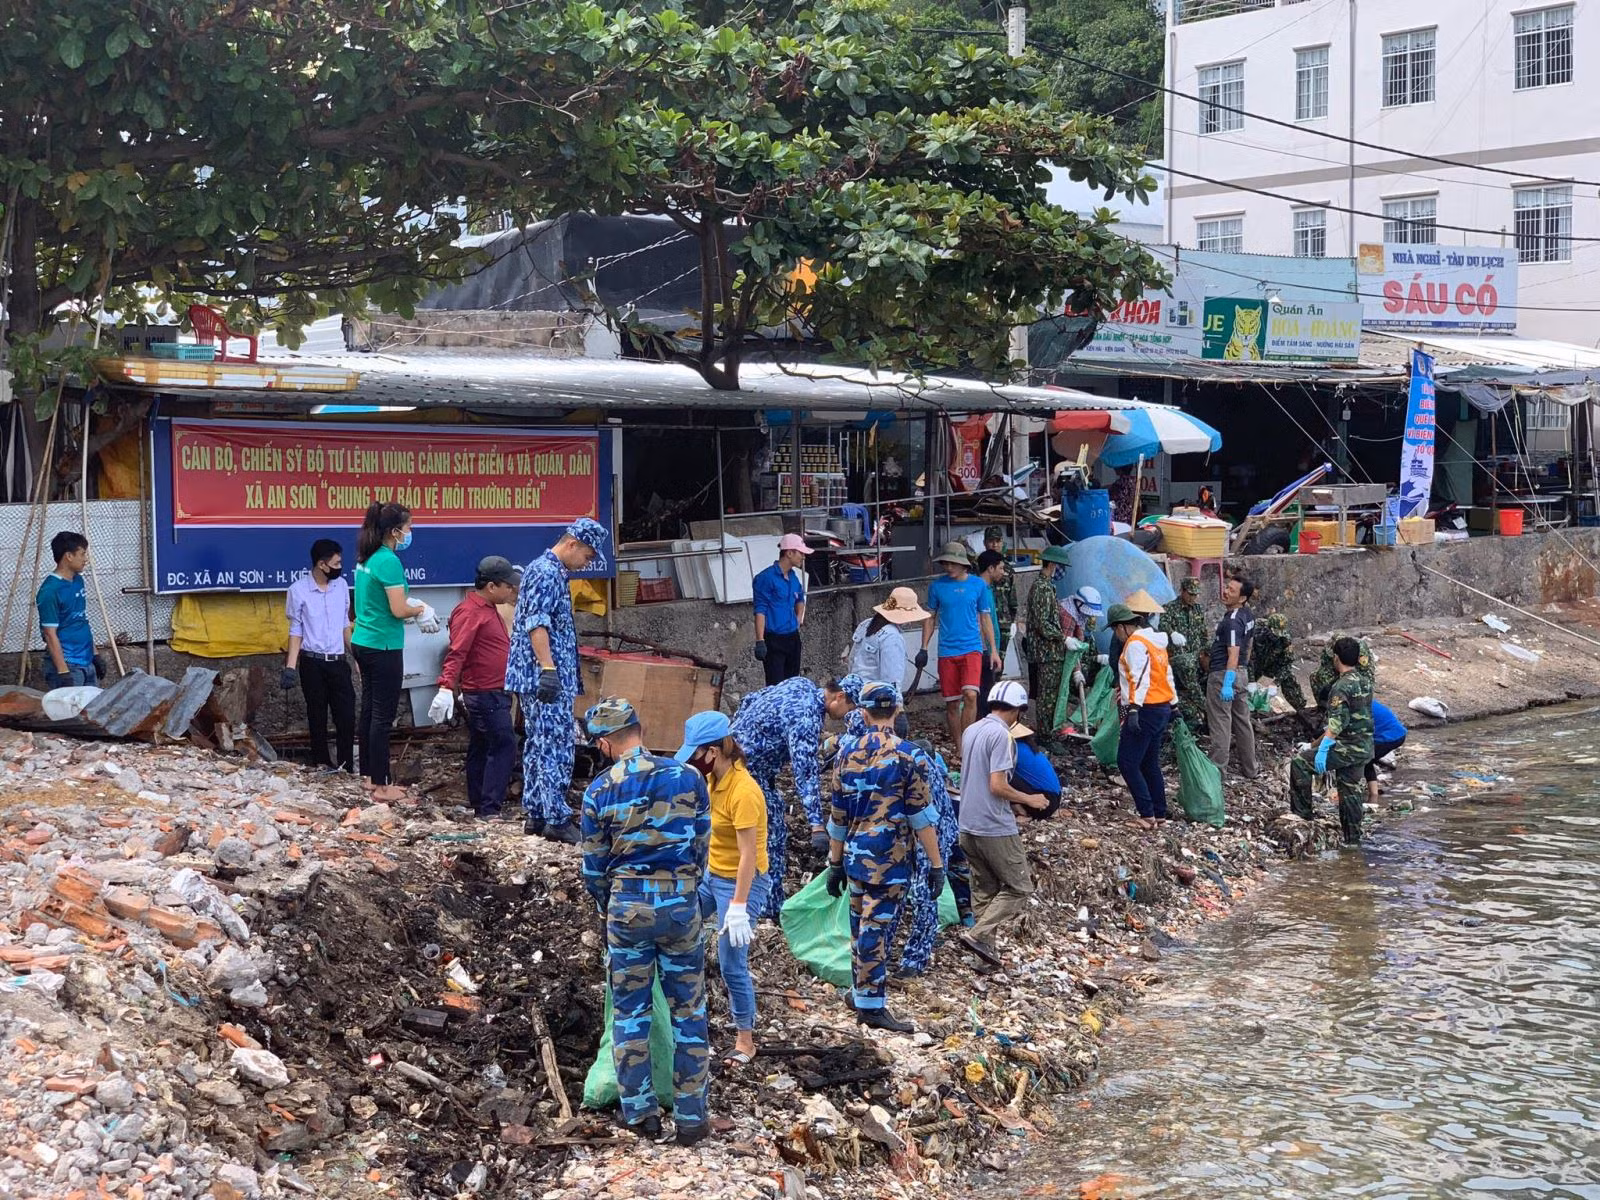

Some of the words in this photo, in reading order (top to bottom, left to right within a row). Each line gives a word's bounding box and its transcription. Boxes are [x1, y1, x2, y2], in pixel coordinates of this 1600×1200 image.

[1392, 250, 1415, 264] NHÀ
[1416, 251, 1441, 265] NGHỈ
[1446, 252, 1465, 266] TÀU
[1466, 256, 1479, 267] DU
[1481, 256, 1505, 269] LỊCH
[1383, 273, 1448, 315] SÁU
[1455, 275, 1498, 316] CÓ
[1272, 303, 1303, 316] Quán
[182, 441, 211, 471] CÁN
[215, 442, 238, 476] BỘ,
[241, 441, 282, 472] CHIẾN
[286, 445, 303, 473] SỸ
[307, 445, 324, 478] BỘ
[328, 448, 345, 473] TƯ
[347, 446, 379, 478] LỆNH
[382, 446, 415, 474] VÙNG
[418, 444, 450, 475] CẢNH
[454, 448, 475, 475] SÁT
[478, 444, 504, 475] BIỂN
[507, 454, 514, 475] 4
[517, 448, 531, 475] VÀ
[534, 450, 566, 478] QUÂN,
[569, 450, 591, 476] DÂN
[245, 481, 264, 509] XÃ
[267, 485, 286, 509] AN
[289, 483, 317, 509] SƠN
[397, 479, 421, 510] BẢO
[424, 482, 439, 514] VỆ
[441, 483, 464, 510] MÔI
[467, 482, 512, 510] TRƯỜNG
[166, 572, 189, 586] ĐC:
[194, 569, 212, 585] XÃ
[216, 571, 234, 585] AN
[239, 570, 264, 584] SƠN
[276, 571, 288, 583] H.
[404, 568, 426, 580] ANG
